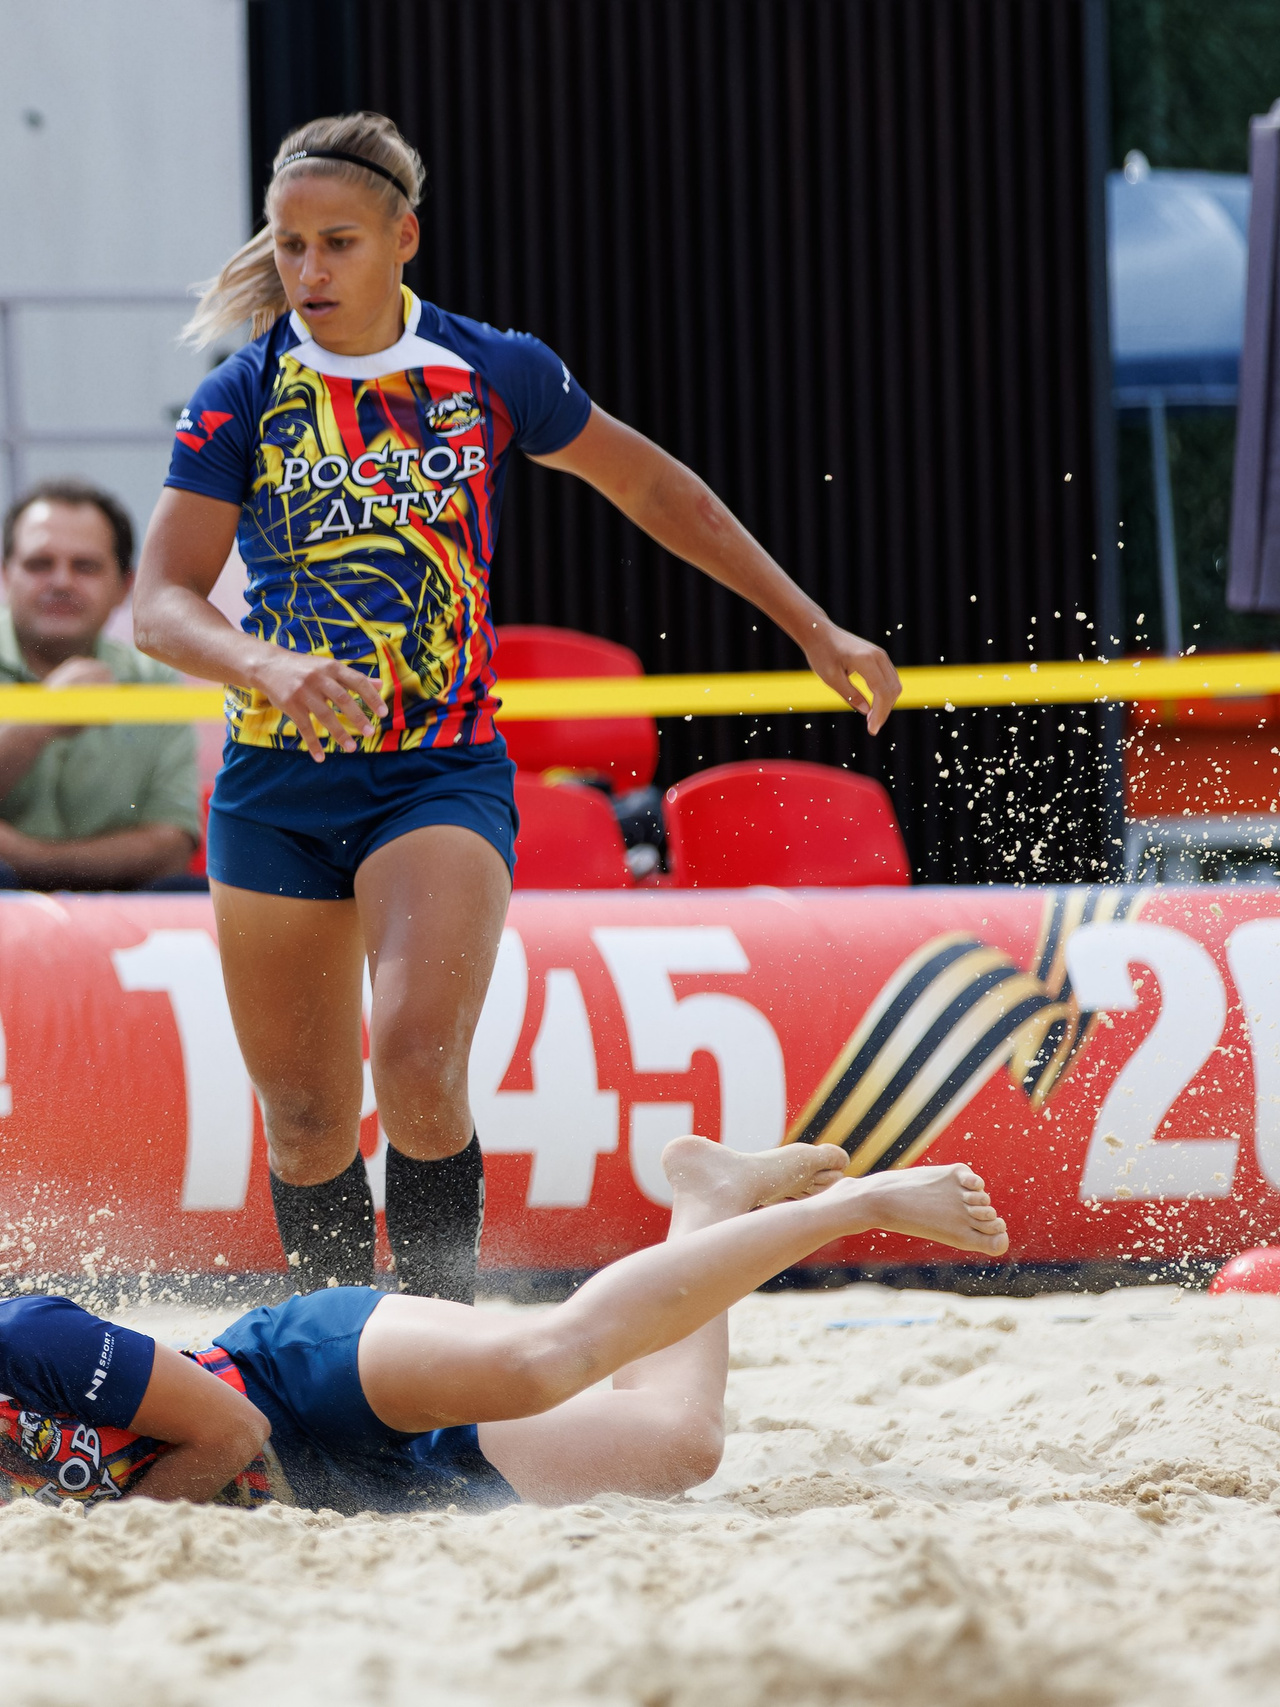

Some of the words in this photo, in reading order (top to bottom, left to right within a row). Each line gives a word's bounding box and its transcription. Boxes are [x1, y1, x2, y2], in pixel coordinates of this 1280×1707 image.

[274, 437, 487, 494] РОСТОВ
[302, 486, 458, 543] ДГТУ
[112, 926, 788, 1211] 145
[99, 1331, 112, 1367] SPORT
